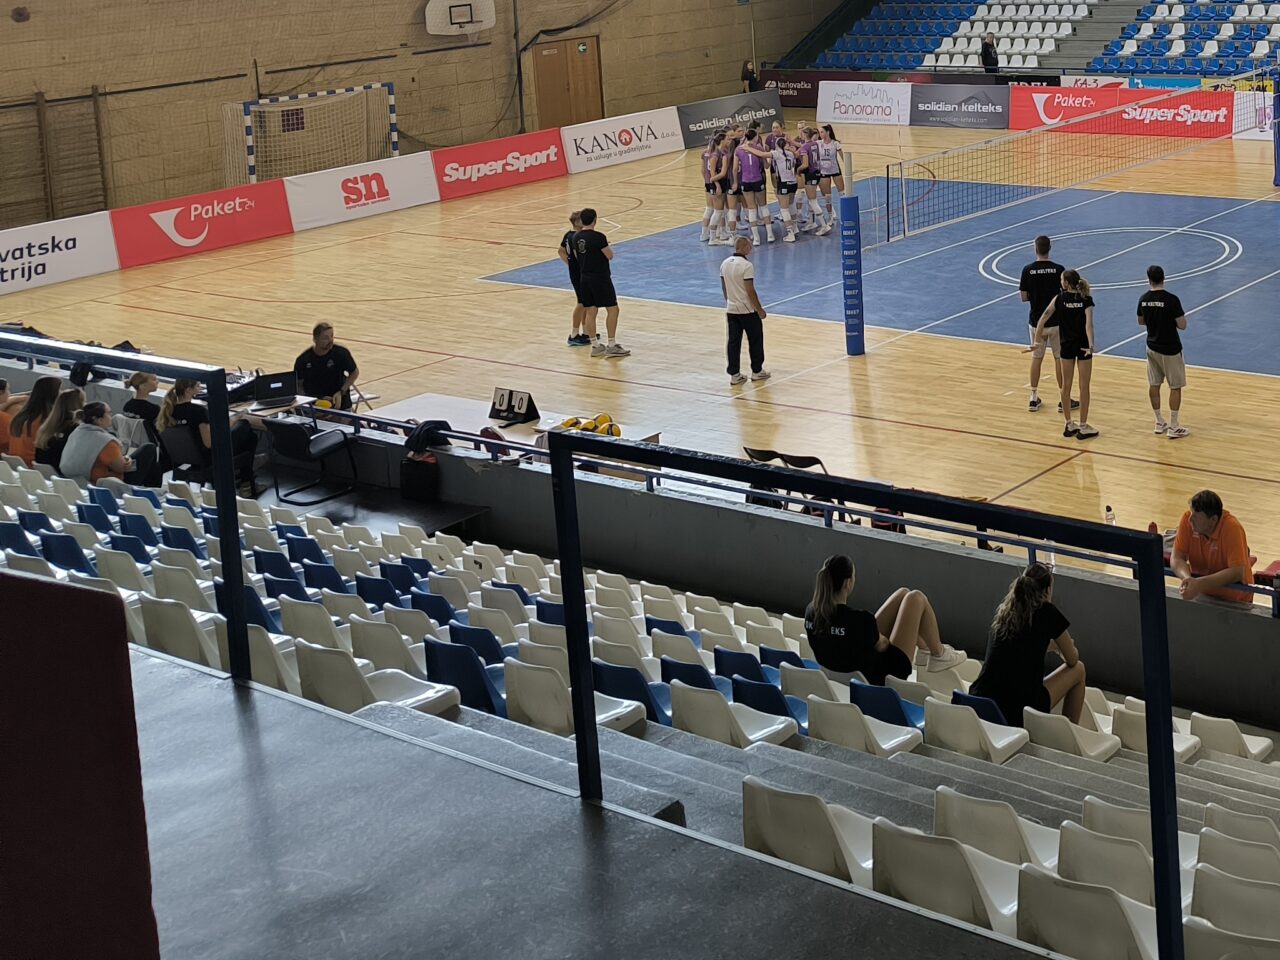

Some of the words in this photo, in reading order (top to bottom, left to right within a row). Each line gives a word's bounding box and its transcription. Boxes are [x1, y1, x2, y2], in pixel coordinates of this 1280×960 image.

[778, 80, 812, 89] karlovačka
[778, 88, 798, 96] banka
[833, 100, 892, 117] Panorama
[918, 101, 959, 112] solidian
[961, 102, 1003, 113] kelteks
[1122, 103, 1229, 124] SuperSport
[688, 115, 732, 132] solidian
[735, 108, 777, 122] kelteks
[443, 145, 558, 183] SuperSport
[341, 172, 390, 206] sn
[498, 393, 505, 408] 0
[517, 397, 524, 411] 0
